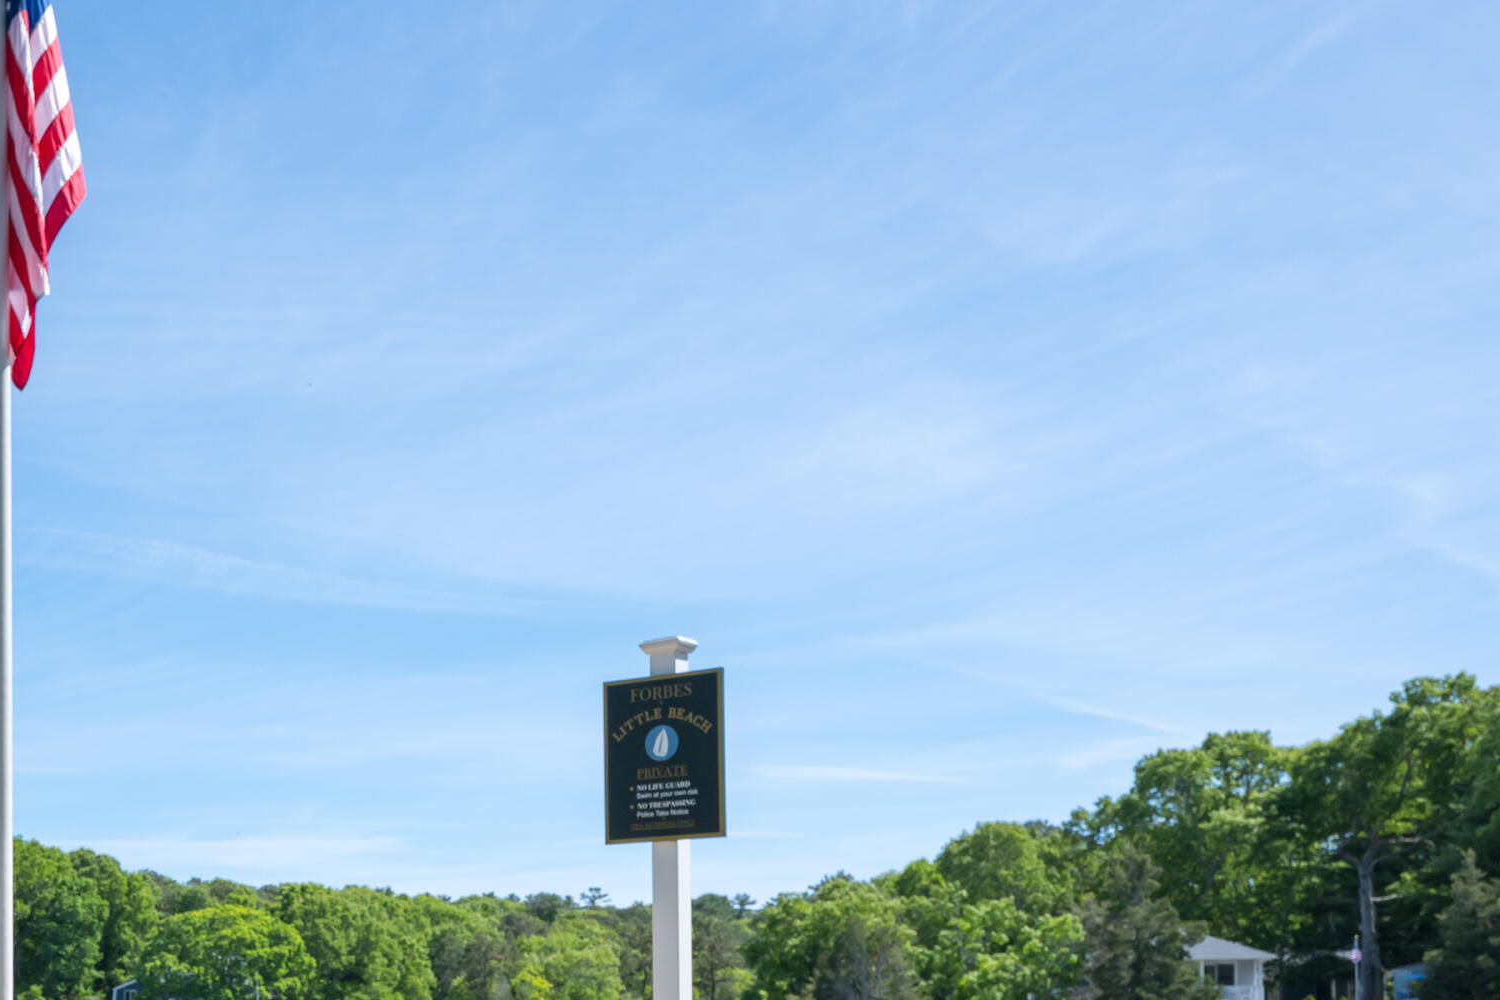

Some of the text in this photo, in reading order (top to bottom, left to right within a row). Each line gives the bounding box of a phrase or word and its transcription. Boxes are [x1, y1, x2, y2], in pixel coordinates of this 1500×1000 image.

[630, 682, 693, 703] FORBES
[612, 706, 714, 742] LITTLE BEACH
[637, 765, 689, 780] PRIVATE
[648, 782, 664, 791] LIFE
[665, 780, 691, 789] GUARD
[660, 791, 673, 799] your
[649, 799, 697, 809] TRESPASSING
[655, 809, 669, 817] Take
[670, 808, 689, 816] Notice
